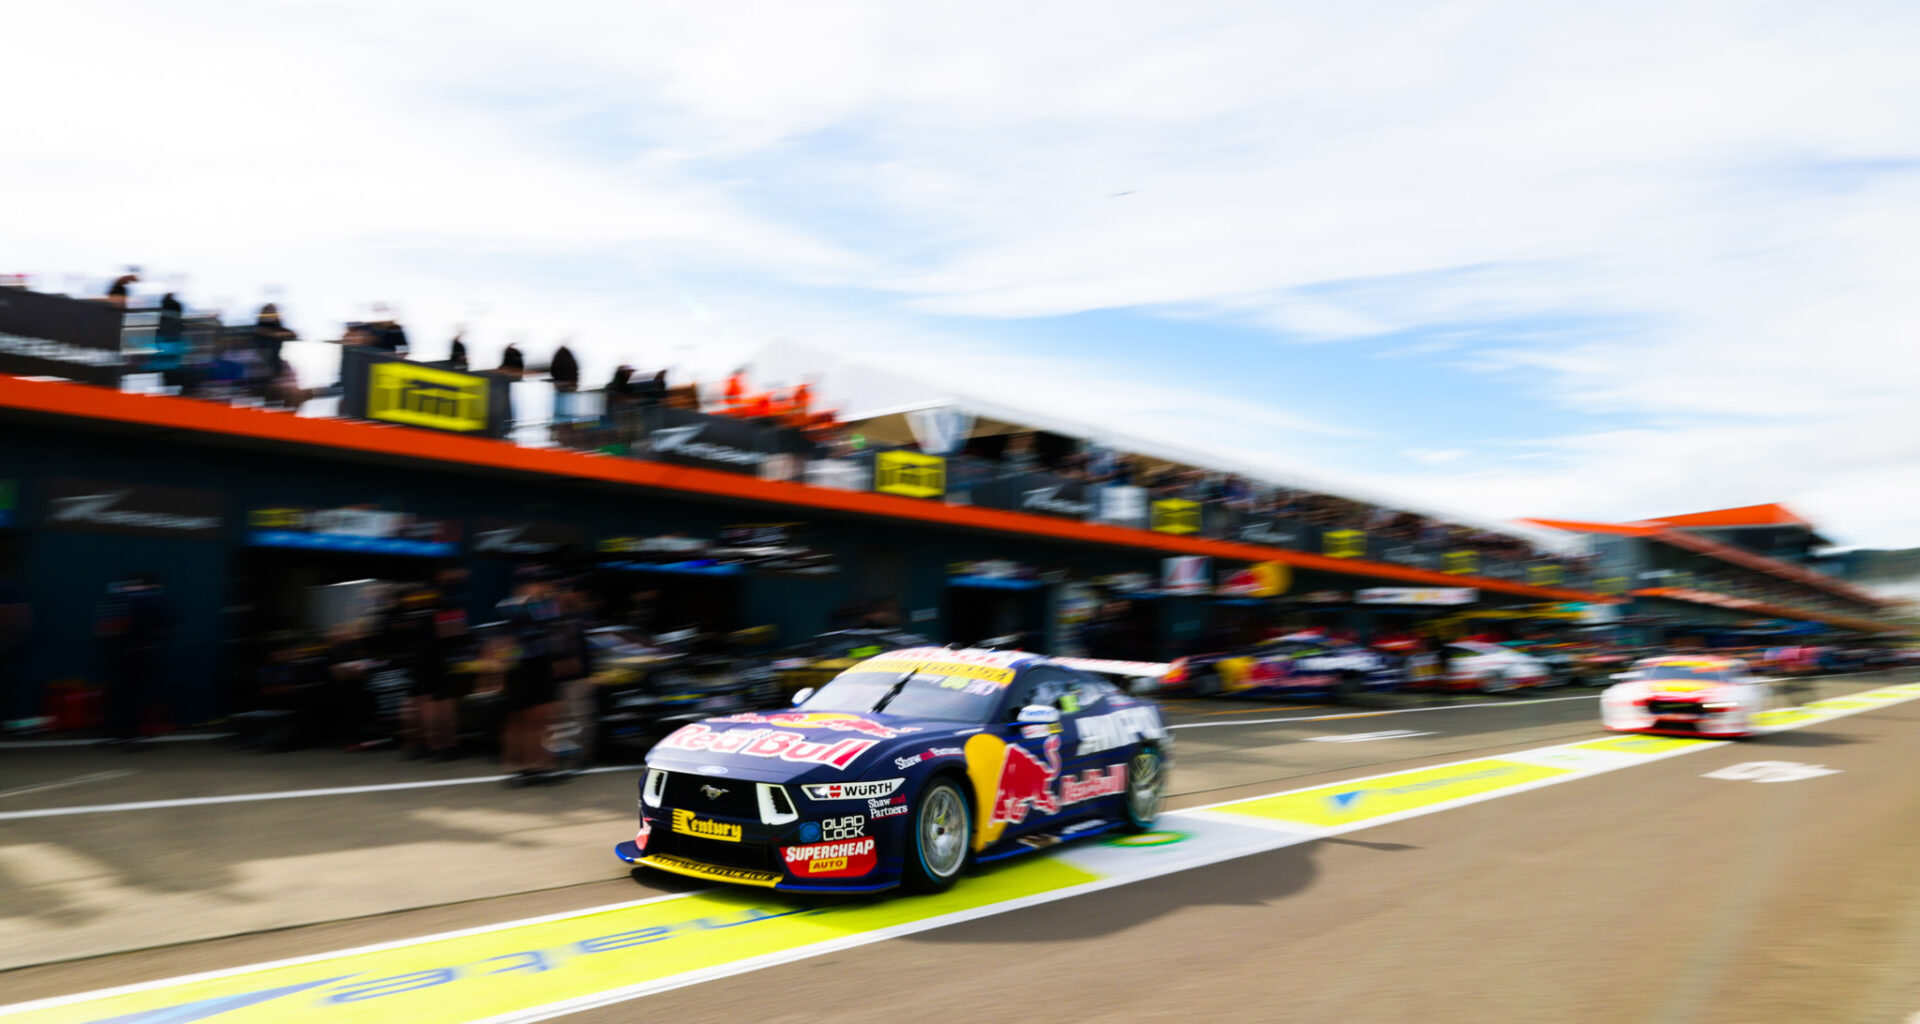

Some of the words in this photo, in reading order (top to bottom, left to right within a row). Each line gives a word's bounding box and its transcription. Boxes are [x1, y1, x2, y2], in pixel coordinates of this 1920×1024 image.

[740, 731, 880, 771] Bull
[844, 781, 893, 797] WÜRTH
[870, 804, 908, 819] Partners
[822, 814, 865, 831] QUAD
[823, 825, 865, 841] LOCK
[785, 839, 875, 863] SUPERCHEAP
[812, 859, 844, 870] AUTO
